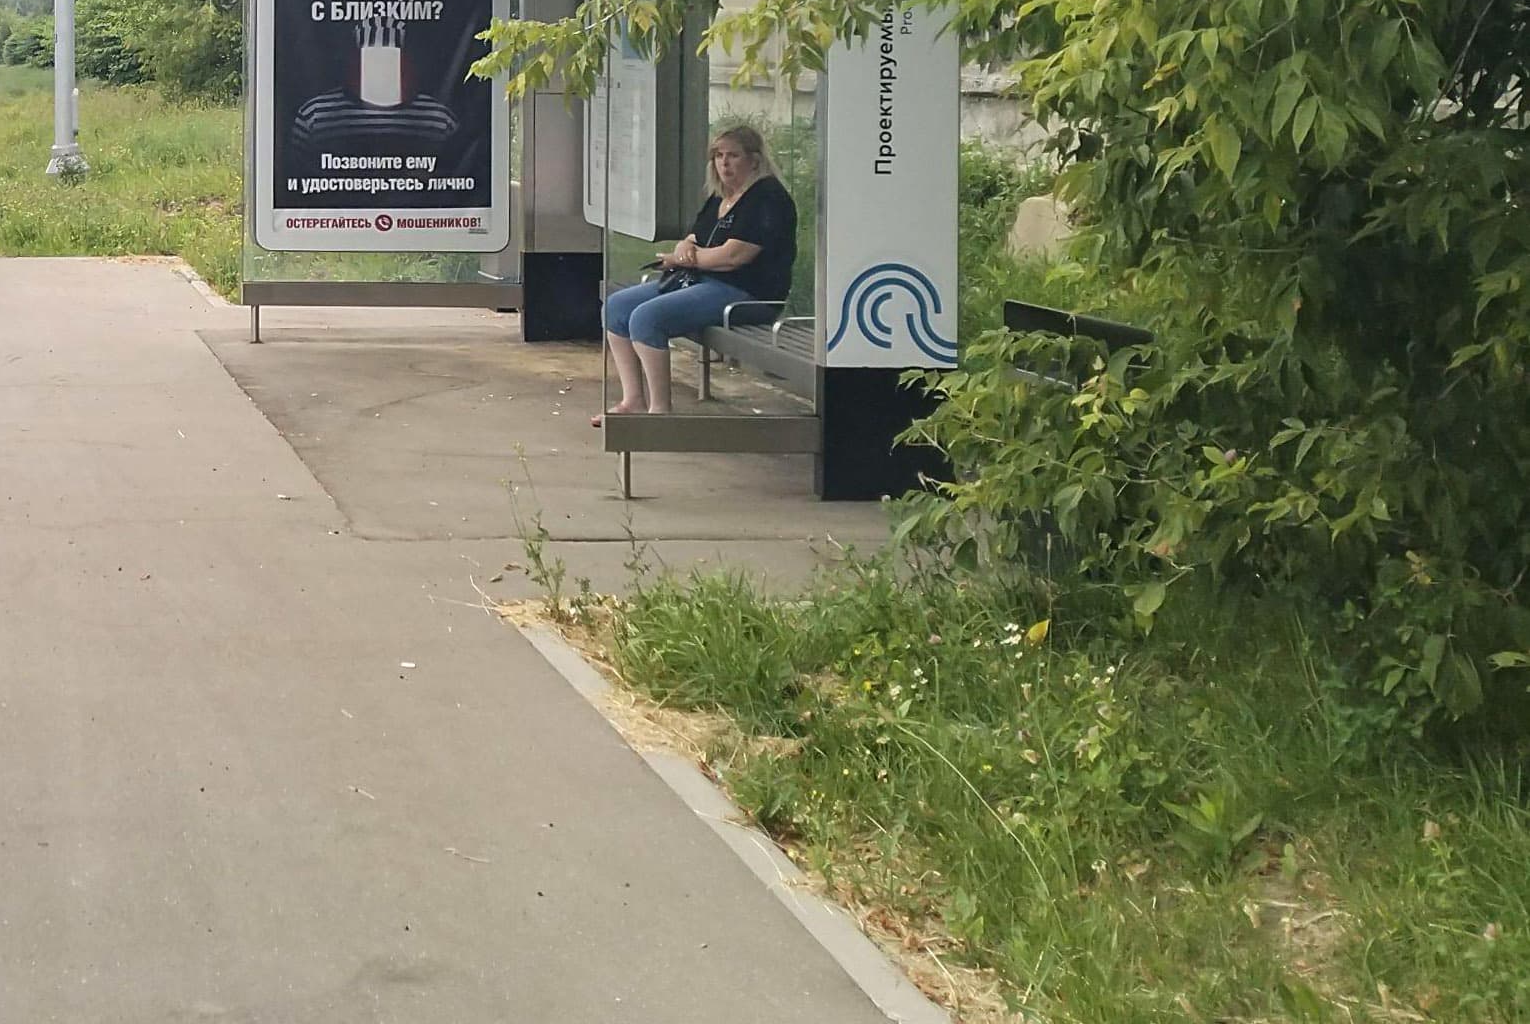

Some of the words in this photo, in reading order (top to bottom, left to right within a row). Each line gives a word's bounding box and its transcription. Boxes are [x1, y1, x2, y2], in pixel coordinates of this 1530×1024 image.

[311, 1, 325, 21] С
[330, 1, 444, 21] БЛИЗКИМ?
[321, 153, 402, 170] Позвоните
[405, 156, 436, 172] ему
[287, 178, 298, 191] и
[301, 177, 424, 194] удостоверьтесь
[427, 177, 475, 191] лично
[286, 216, 372, 229] ОСТЕРЕГАЙТЕСЬ
[396, 217, 482, 229] МОШЕННИКОВ!
